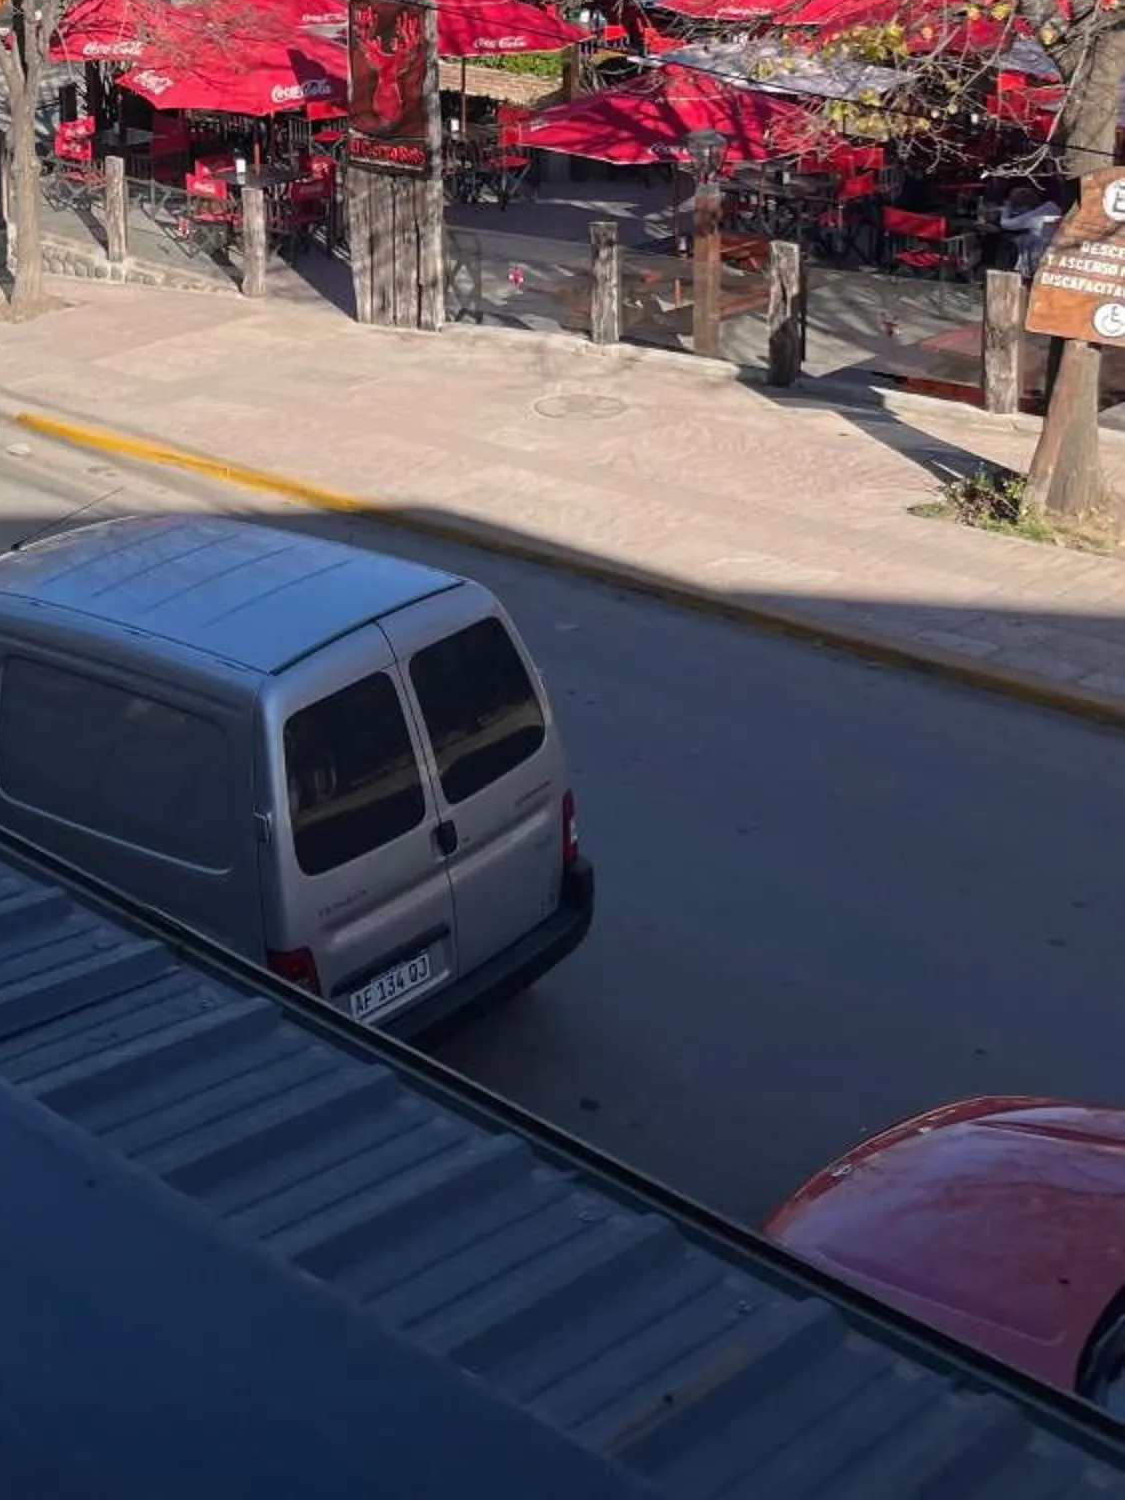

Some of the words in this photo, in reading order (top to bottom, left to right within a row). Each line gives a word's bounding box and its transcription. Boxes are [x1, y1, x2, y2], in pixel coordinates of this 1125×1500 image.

[271, 80, 332, 103] Coca-Cola
[1040, 271, 1125, 298] DISCAPACITA
[377, 973, 405, 1002] 134
